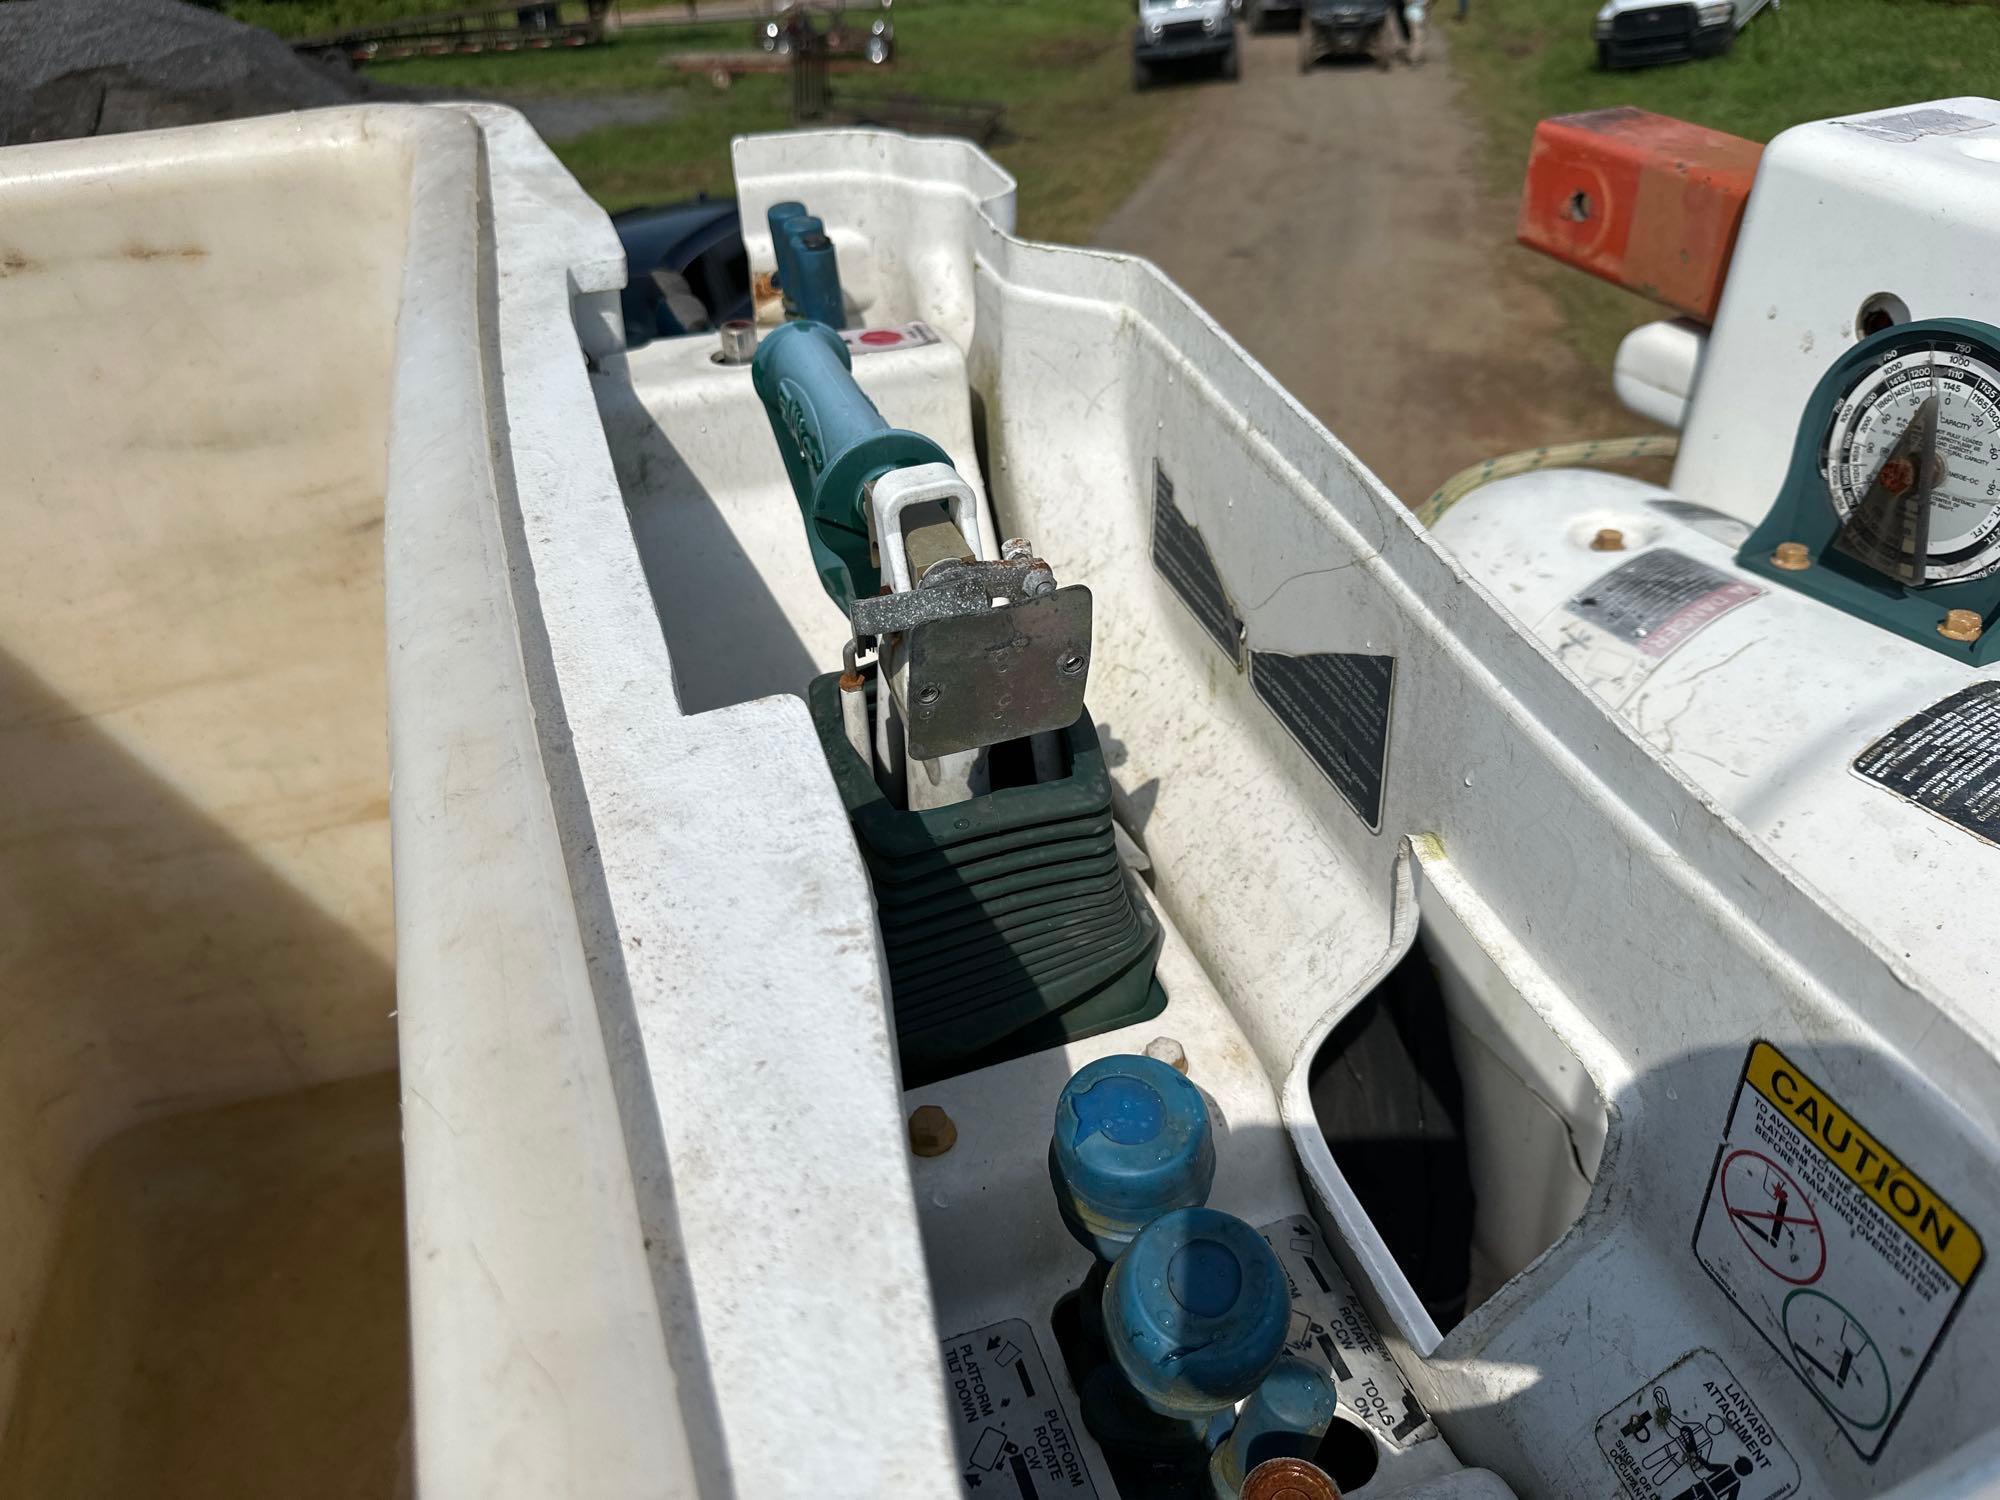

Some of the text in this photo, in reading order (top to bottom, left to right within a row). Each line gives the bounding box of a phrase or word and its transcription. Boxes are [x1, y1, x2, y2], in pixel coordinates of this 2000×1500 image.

[1955, 344, 1971, 353] 750
[1884, 361, 1902, 375] 1000
[1910, 368, 1930, 377] 1200
[1949, 355, 1970, 368] 1000
[1889, 375, 1906, 387] 1415
[1895, 386, 1911, 398] 1455
[1912, 380, 1931, 389] 1230
[1943, 382, 1961, 392] 1145
[1980, 381, 1996, 399] 1135
[1909, 397, 1920, 406] 30
[1945, 397, 1950, 405] 0
[1971, 393, 1989, 410] 1165
[1940, 417, 1972, 431] CAPACITY
[1961, 435, 1983, 447] LOADED
[1654, 595, 1730, 649] DANGER
[1962, 748, 1978, 757] the
[1875, 766, 1889, 778] are
[1901, 767, 1917, 781] and
[1909, 756, 1964, 799] manufacturer's
[1945, 751, 1988, 783] maintained
[1931, 780, 1947, 794] and
[1932, 753, 2000, 806] operating properly
[1963, 781, 1996, 806] material
[1771, 1070, 1956, 1252] CAUTION
[1755, 1098, 1951, 1292] TO AVOID MACHINE DAMAGE RETURN
[1756, 1113, 1941, 1297] PLATFORM TO STOWED POSTITION
[1755, 1124, 1933, 1302] BEFORE TRAVELING OVERCENTER
[1330, 1319, 1355, 1351] CCW
[1339, 1307, 1374, 1355] ROTATE
[1346, 1295, 1392, 1362] PLATFORM
[946, 1348, 979, 1423] TILT DOWN
[960, 1344, 994, 1417] PLATFORM
[1354, 1397, 1374, 1419] ON
[1362, 1378, 1395, 1427] TOOLS
[1703, 1381, 1772, 1469] ATTACHMENT
[1724, 1383, 1773, 1447] LANYARD
[1024, 1446, 1043, 1470] CW
[1034, 1426, 1064, 1481] ROTATE
[1044, 1409, 1084, 1488] PLATFORM
[1615, 1440, 1652, 1492] SINGLE OR
